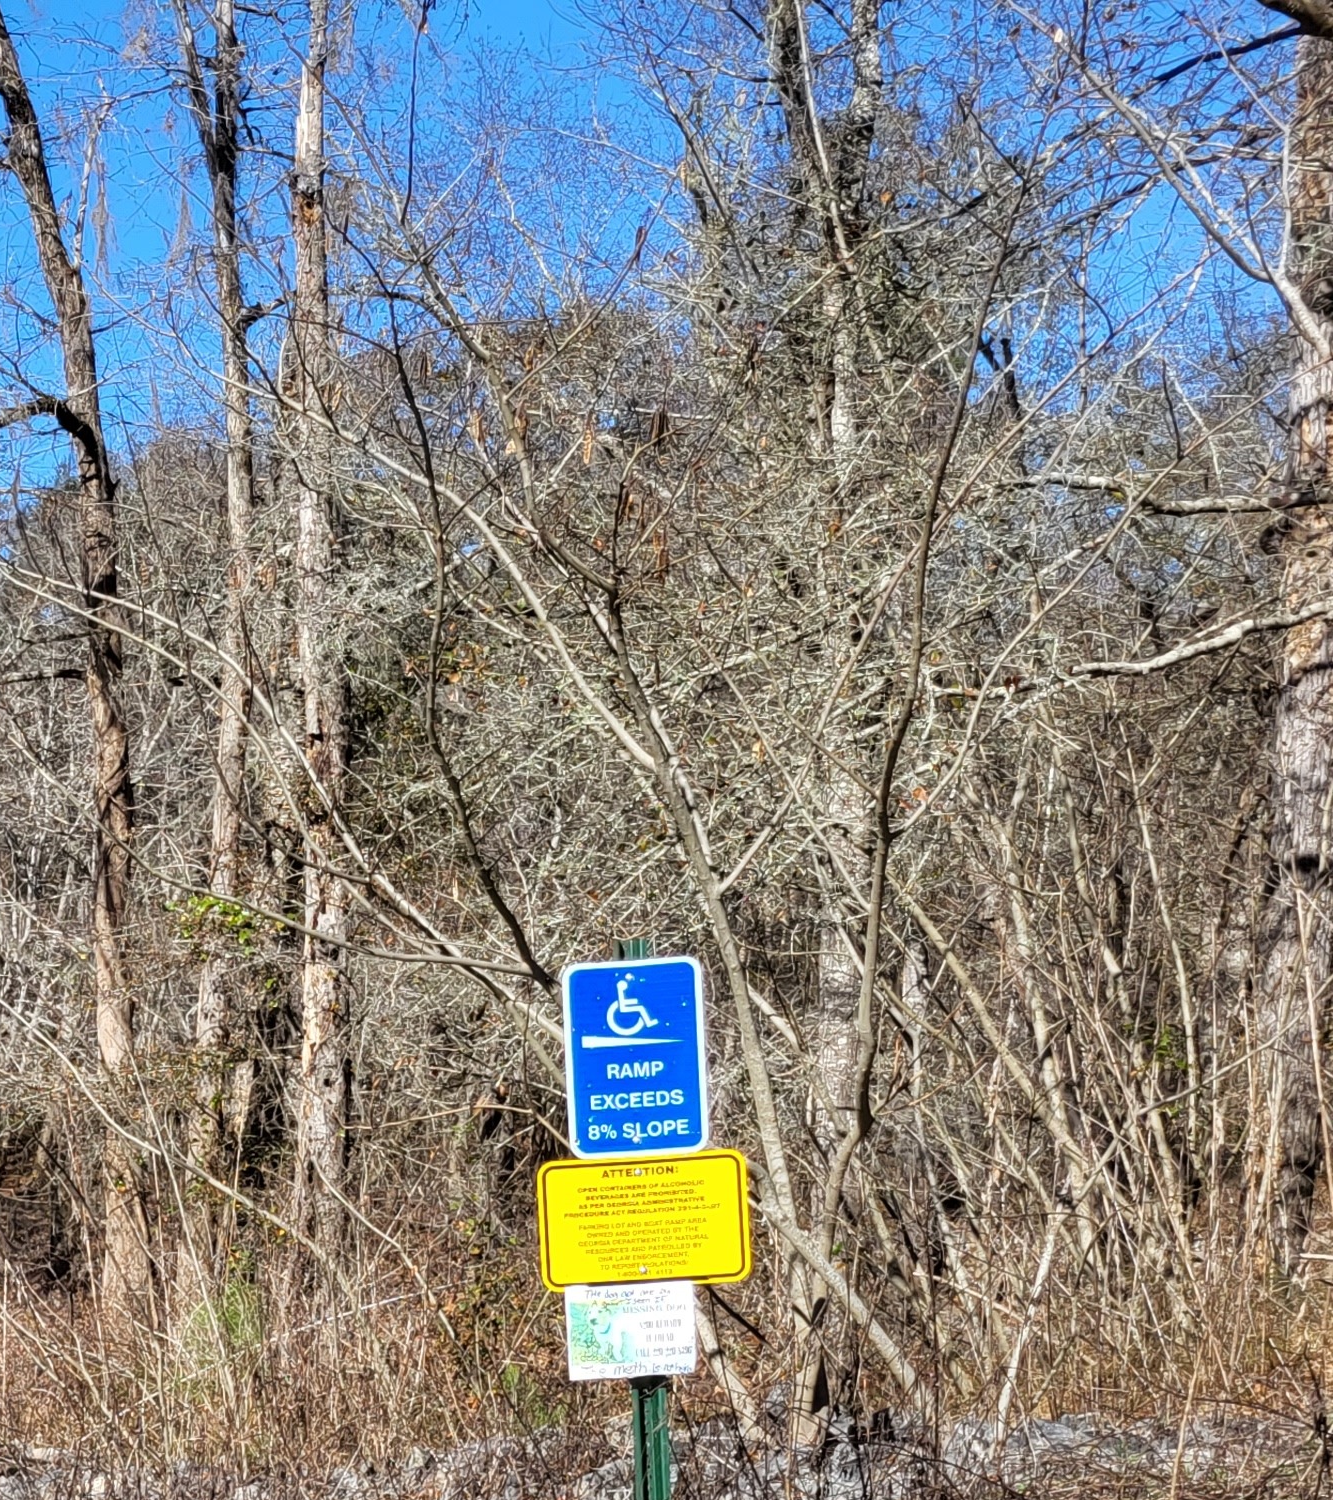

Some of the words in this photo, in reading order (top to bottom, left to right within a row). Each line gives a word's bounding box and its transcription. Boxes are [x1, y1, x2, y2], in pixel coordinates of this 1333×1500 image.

[607, 1061, 664, 1079] RAMP
[590, 1089, 684, 1111] EXCEEDS
[588, 1124, 617, 1140] 8%
[623, 1119, 689, 1139] SLOPE
